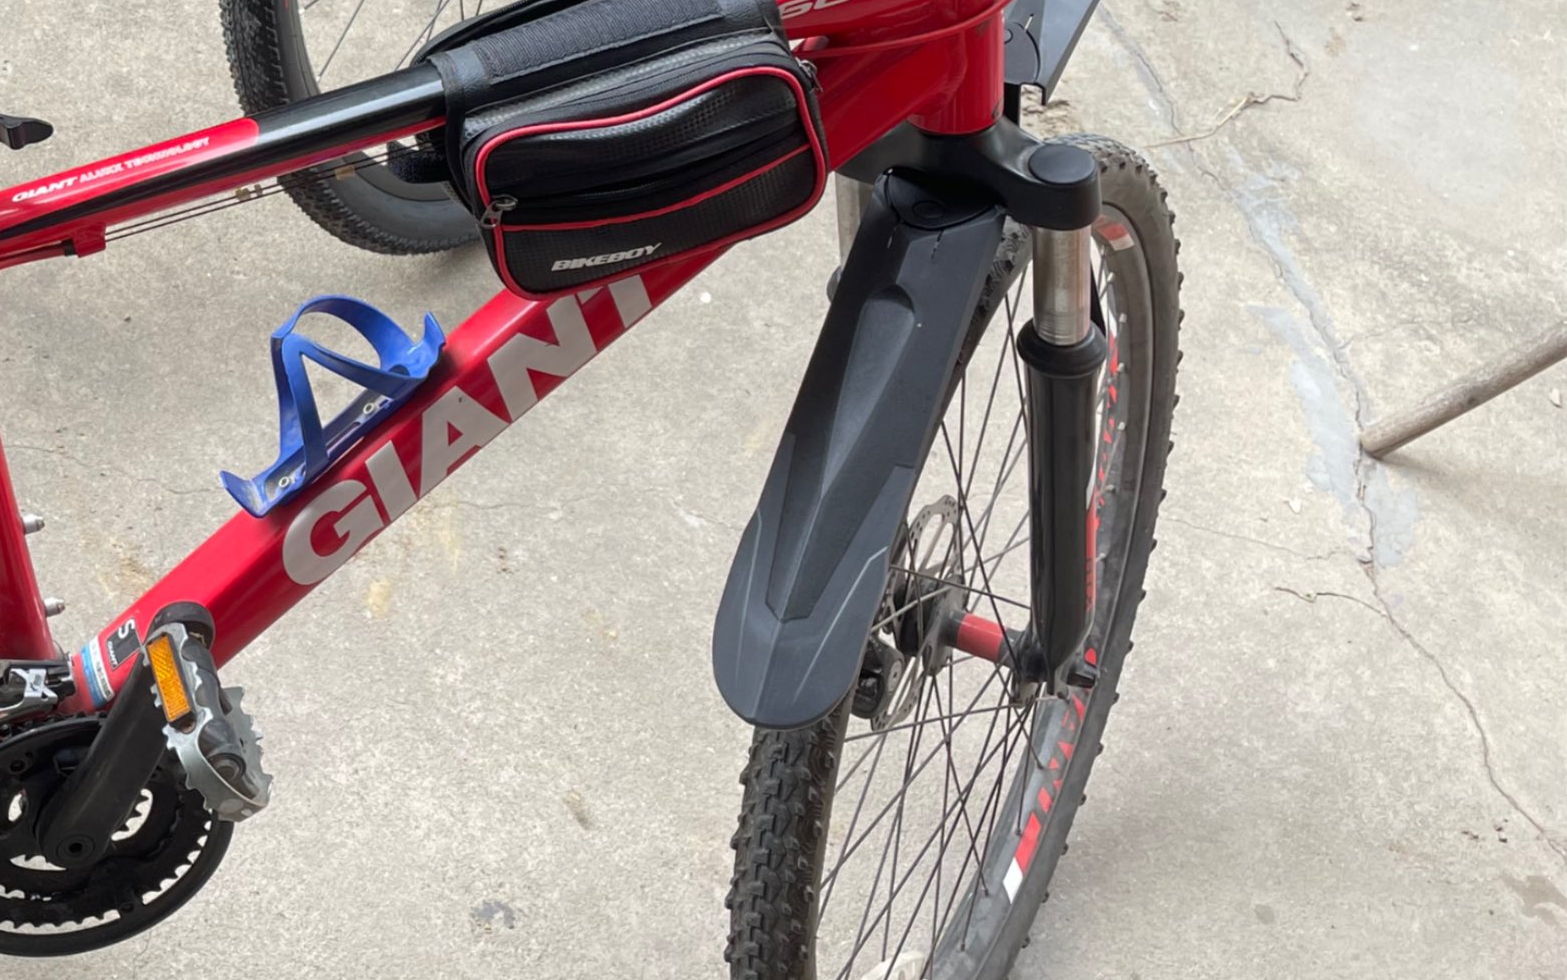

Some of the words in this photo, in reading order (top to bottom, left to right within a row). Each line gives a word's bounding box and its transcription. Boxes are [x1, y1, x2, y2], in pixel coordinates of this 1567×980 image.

[11, 176, 78, 203] GIANT
[551, 242, 663, 272] BIKEBOY
[118, 618, 135, 639] S
